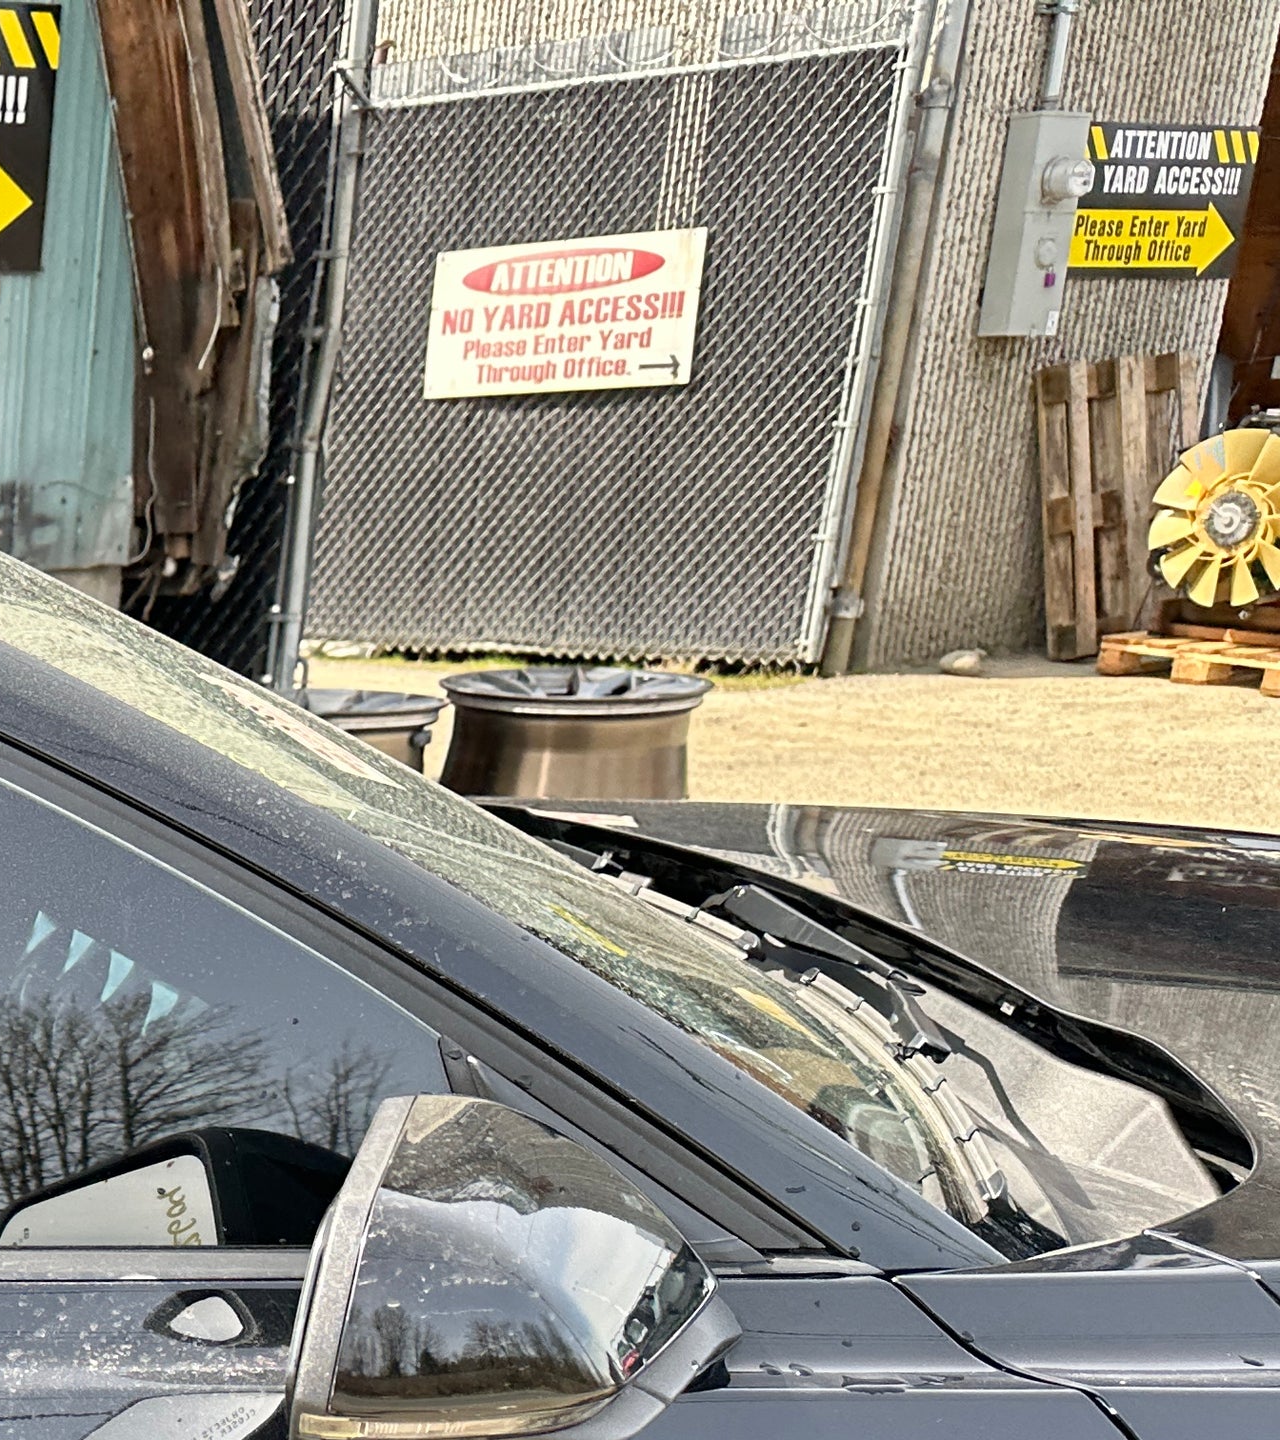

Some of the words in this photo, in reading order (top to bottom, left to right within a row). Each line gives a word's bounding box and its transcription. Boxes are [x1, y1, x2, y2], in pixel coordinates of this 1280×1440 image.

[1110, 129, 1212, 161] ATTENTION
[1102, 165, 1150, 194] YARD
[1153, 167, 1242, 195] ACCESS!!!
[1074, 215, 1123, 238] Please
[1129, 217, 1170, 238] Enter
[1175, 216, 1208, 238] Yard
[1084, 240, 1141, 265] Through
[1147, 241, 1192, 261] Office
[490, 251, 634, 291] ATTENTION
[442, 309, 474, 336] NO
[484, 302, 551, 332] YARD
[558, 291, 686, 327] ACCESS!!!
[463, 339, 527, 360] Please
[533, 334, 591, 354] Enter
[598, 327, 652, 350] Yard
[477, 360, 557, 384] Through
